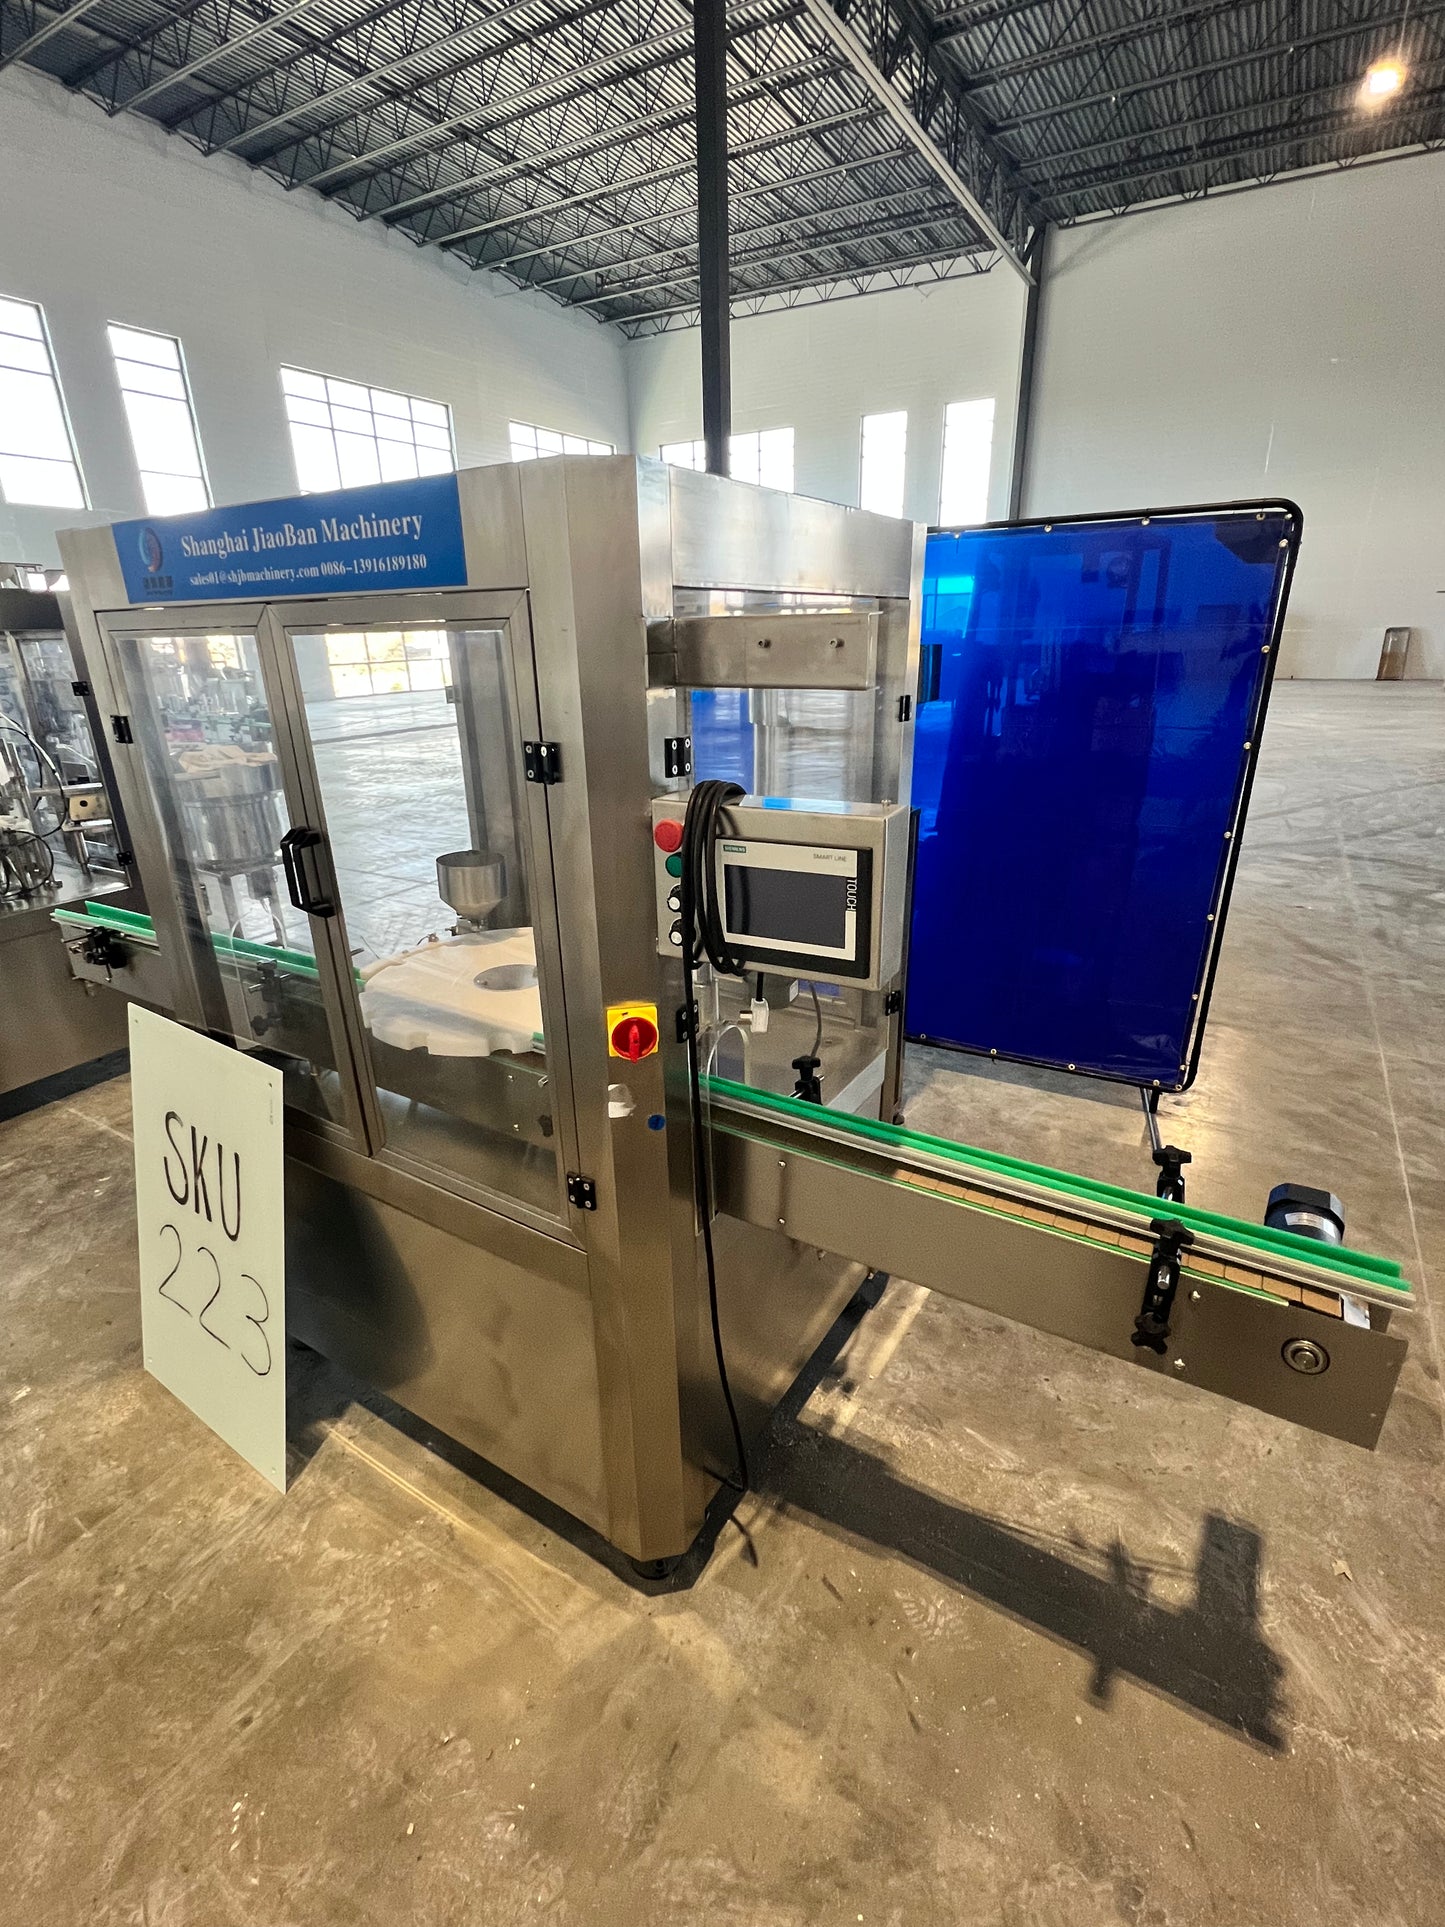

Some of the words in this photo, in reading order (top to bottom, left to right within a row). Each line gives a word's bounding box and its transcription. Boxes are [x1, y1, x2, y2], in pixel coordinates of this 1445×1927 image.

[181, 531, 249, 559] Shanghai
[252, 523, 318, 552] JiaoBan
[320, 512, 423, 541] Machinery
[320, 553, 427, 577] 0086-13916189180
[846, 879, 858, 911] TOUCH
[163, 1111, 241, 1242] SKU
[158, 1224, 272, 1376] 223
